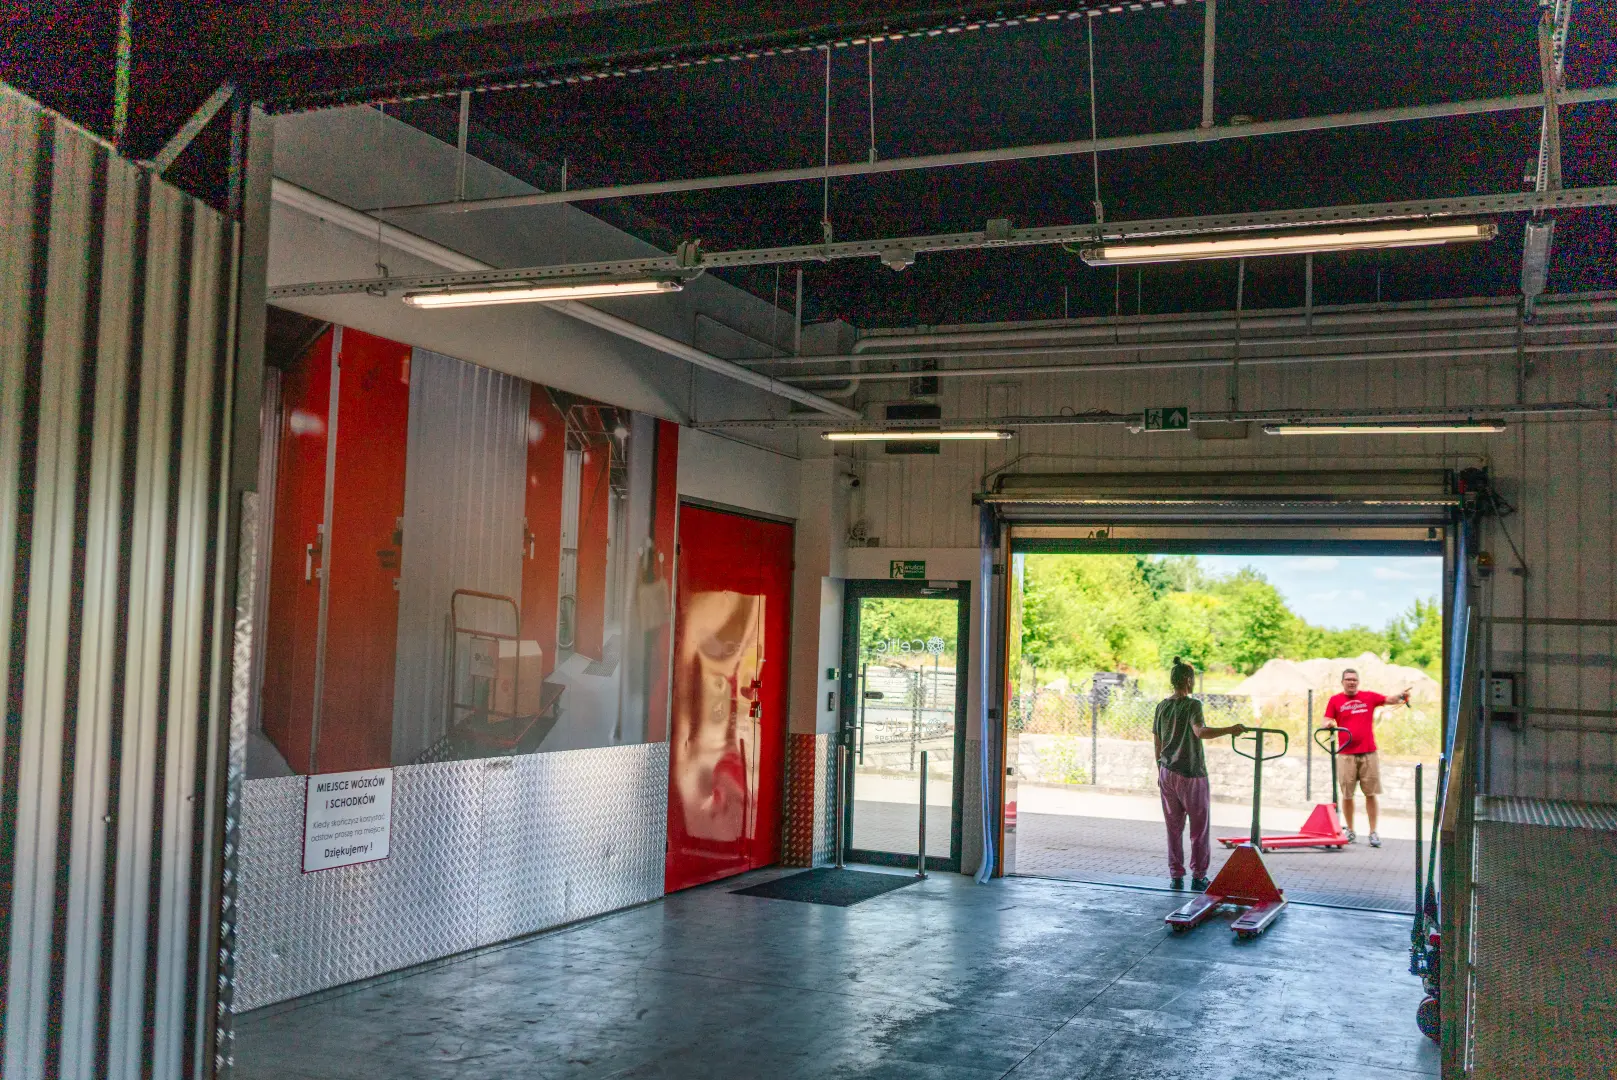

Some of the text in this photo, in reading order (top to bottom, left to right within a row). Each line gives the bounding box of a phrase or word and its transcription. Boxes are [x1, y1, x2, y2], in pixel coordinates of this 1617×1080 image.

[317, 776, 385, 792] MIEJSCE WÓZKÓW
[330, 793, 376, 809] SCHODKÓW
[312, 821, 330, 829] Kiedy
[311, 833, 333, 842] odstaw
[364, 826, 385, 836] miejsce
[324, 844, 369, 858] Dziękujemy
